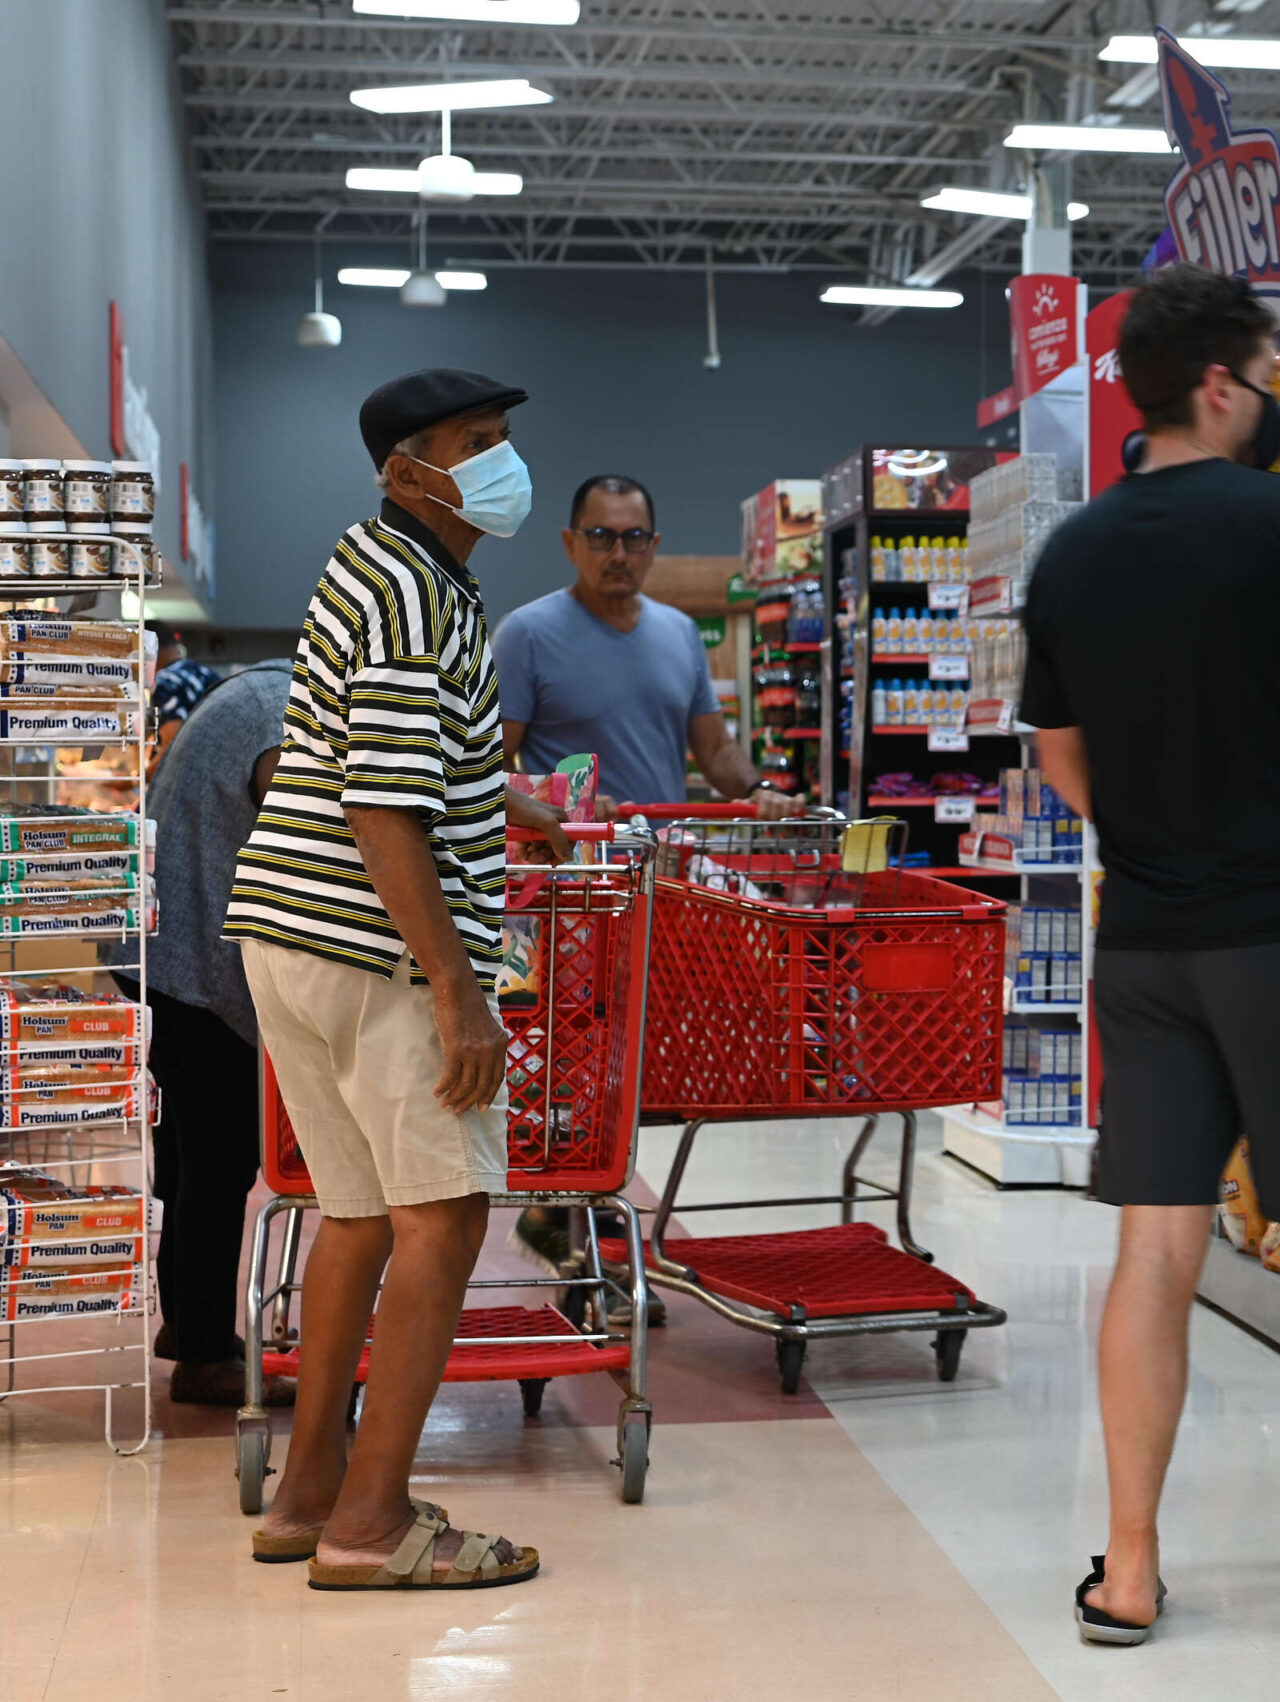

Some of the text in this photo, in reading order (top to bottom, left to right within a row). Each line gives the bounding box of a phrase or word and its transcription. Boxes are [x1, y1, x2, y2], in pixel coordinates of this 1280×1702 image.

[31, 629, 69, 639] PAN CLUB
[86, 663, 130, 679] Quality
[33, 686, 55, 695] CLUB
[10, 716, 117, 731] Premium Quality
[23, 831, 67, 841] Holsum
[73, 833, 121, 843] INTEGRAL
[26, 839, 65, 849] PAN CLUB
[26, 855, 128, 873] Premium Quality
[21, 913, 125, 931] Premium Quality
[23, 1016, 66, 1026] Holsum
[37, 1025, 53, 1034] PAN
[83, 1021, 109, 1032] CLUB
[20, 1046, 122, 1060] Premium Quality
[84, 1087, 111, 1096] CLUB
[21, 1107, 123, 1124] Premium Quality
[36, 1213, 79, 1222] Holsum
[96, 1217, 122, 1227] CLUB
[49, 1222, 65, 1230] PAN
[31, 1242, 133, 1257] Premium Quality
[35, 1280, 51, 1289] PAN
[82, 1275, 109, 1285] CLUB
[17, 1299, 119, 1315] Premium Quality
